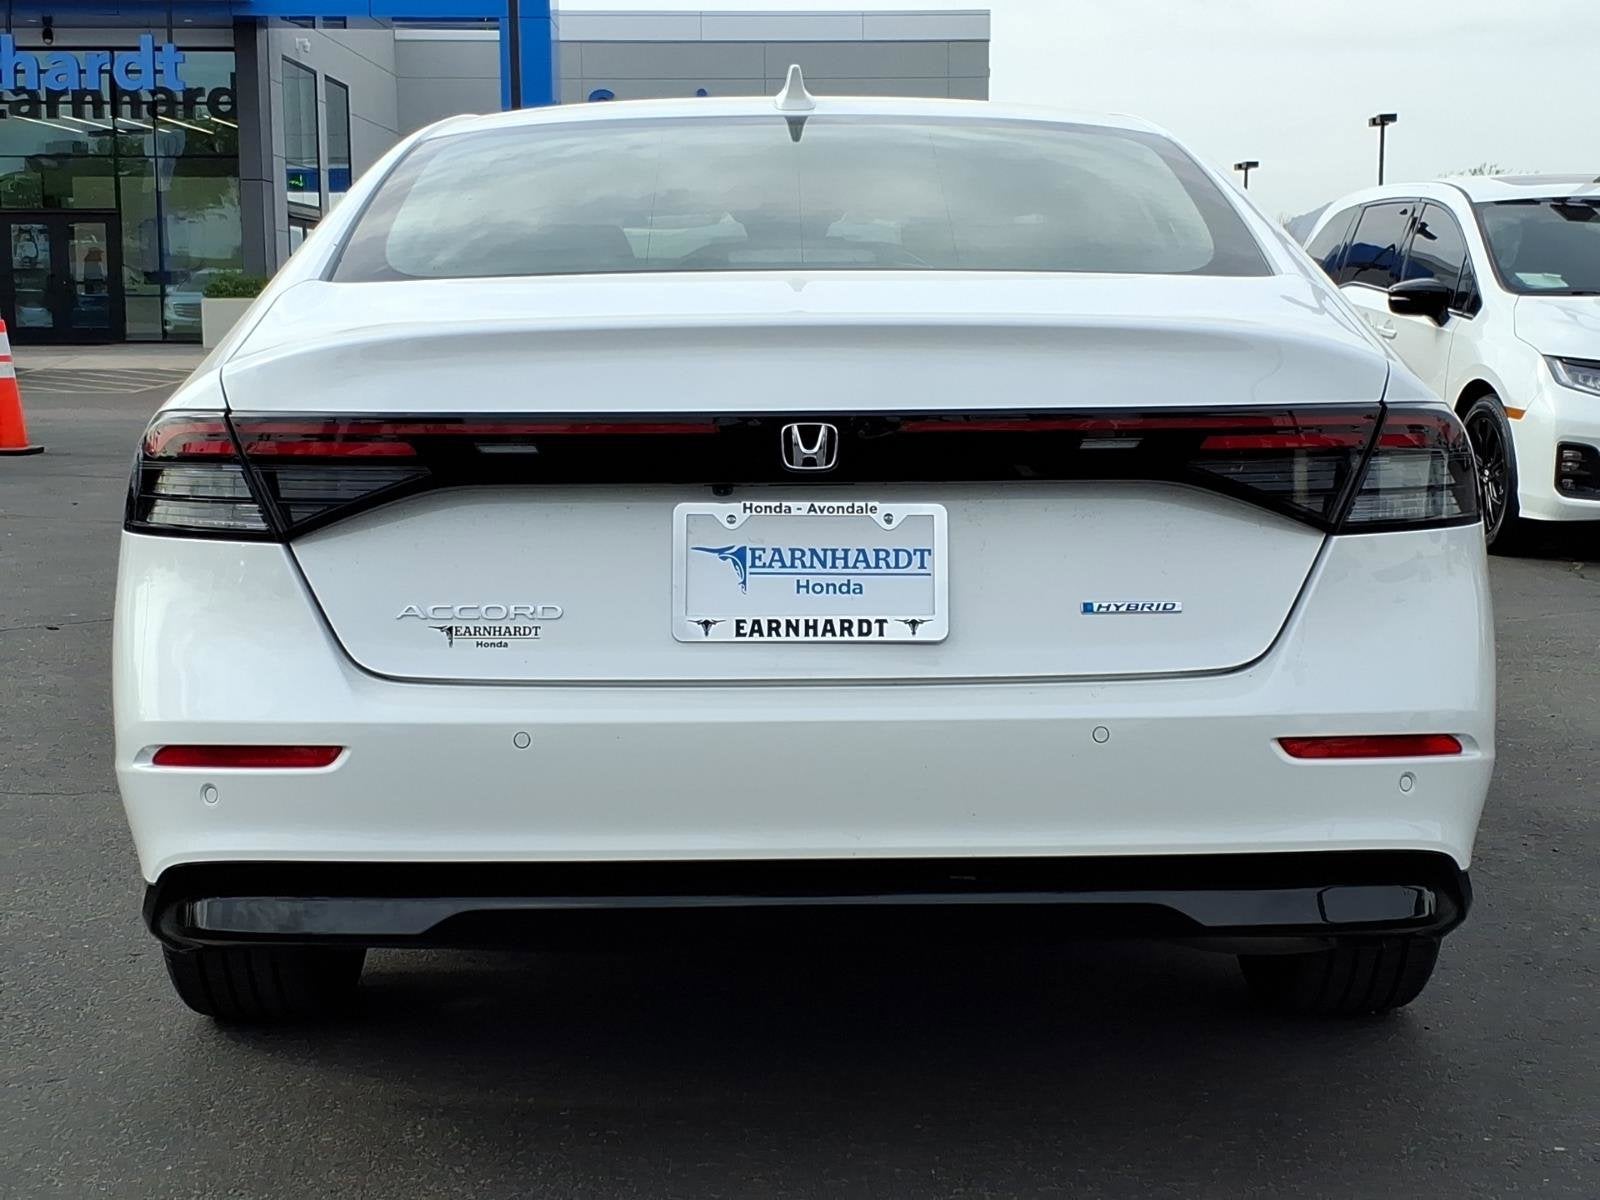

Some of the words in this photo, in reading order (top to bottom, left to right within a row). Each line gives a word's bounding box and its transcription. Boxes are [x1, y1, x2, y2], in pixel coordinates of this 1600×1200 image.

[0, 34, 186, 91] hardt
[0, 72, 238, 119] arnard
[742, 502, 792, 515] Honda
[806, 502, 878, 515] Avondale
[749, 547, 932, 571] EARNHARDT
[796, 579, 864, 595] Honda
[396, 604, 564, 621] ACCORD
[1096, 602, 1177, 612] HYBRID
[454, 625, 542, 637] EARNHARDT
[734, 618, 889, 638] EARNHARDT
[475, 640, 509, 649] Honda
